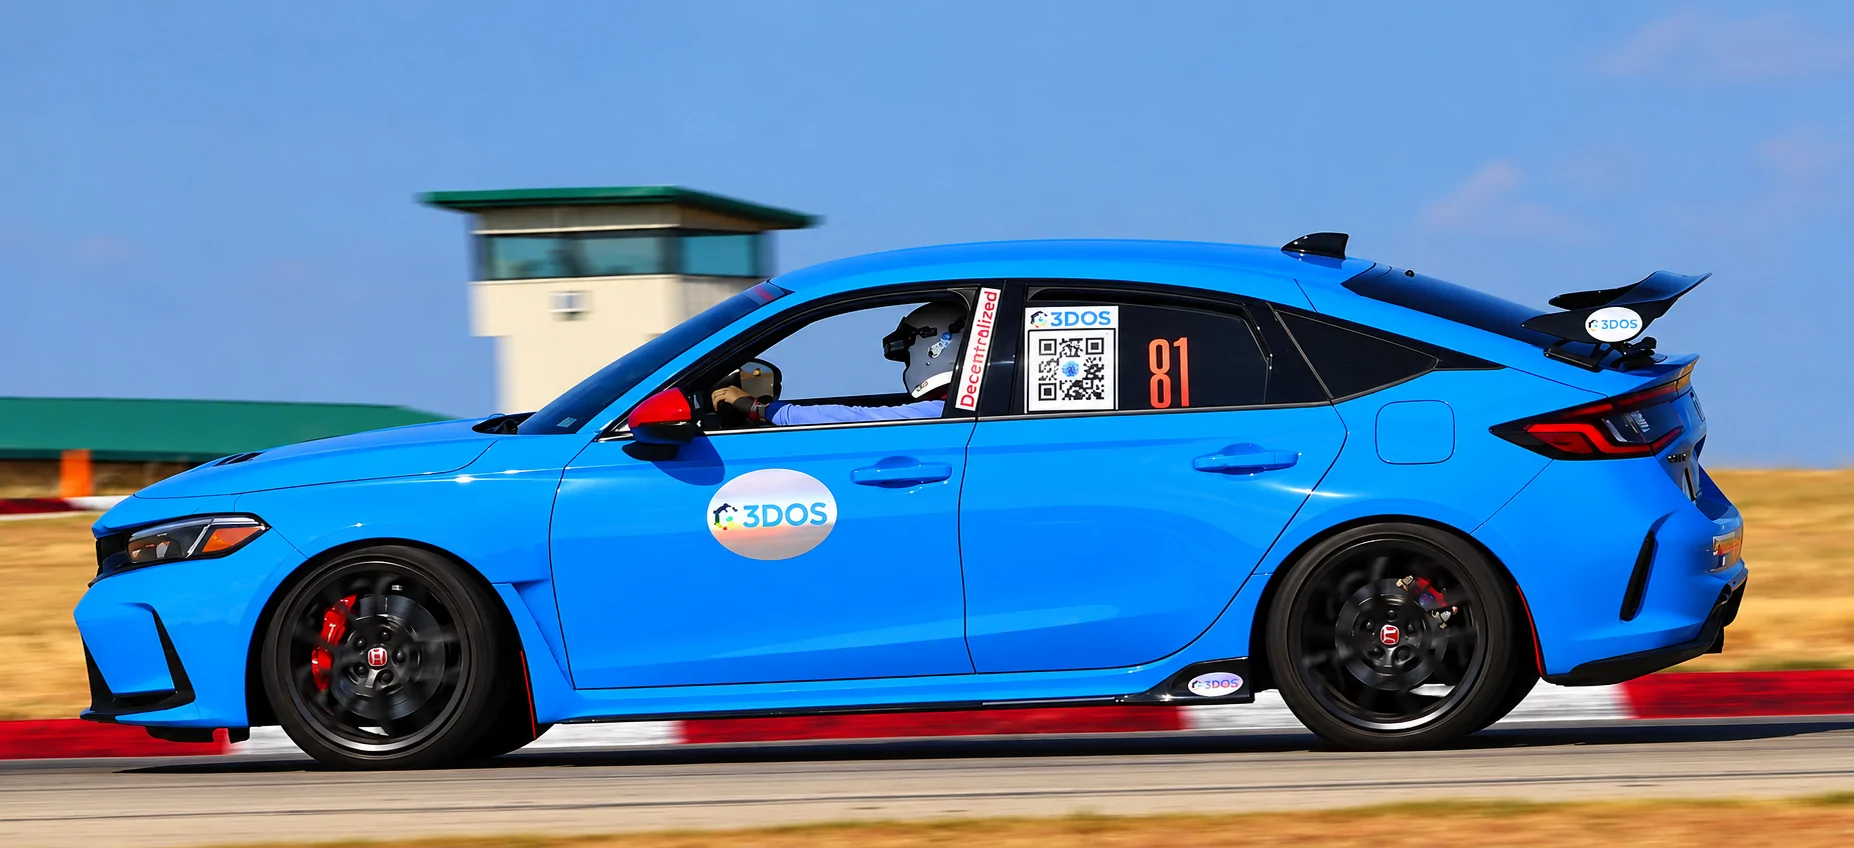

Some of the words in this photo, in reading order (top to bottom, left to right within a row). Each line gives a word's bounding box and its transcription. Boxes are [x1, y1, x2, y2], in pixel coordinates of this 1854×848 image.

[1050, 310, 1112, 327] 3DOS
[1601, 319, 1638, 330] 3DOS
[960, 291, 997, 408] Decentralized
[1149, 337, 1190, 409] 81
[742, 502, 828, 528] 3DOS
[1204, 678, 1239, 690] 3DOS
